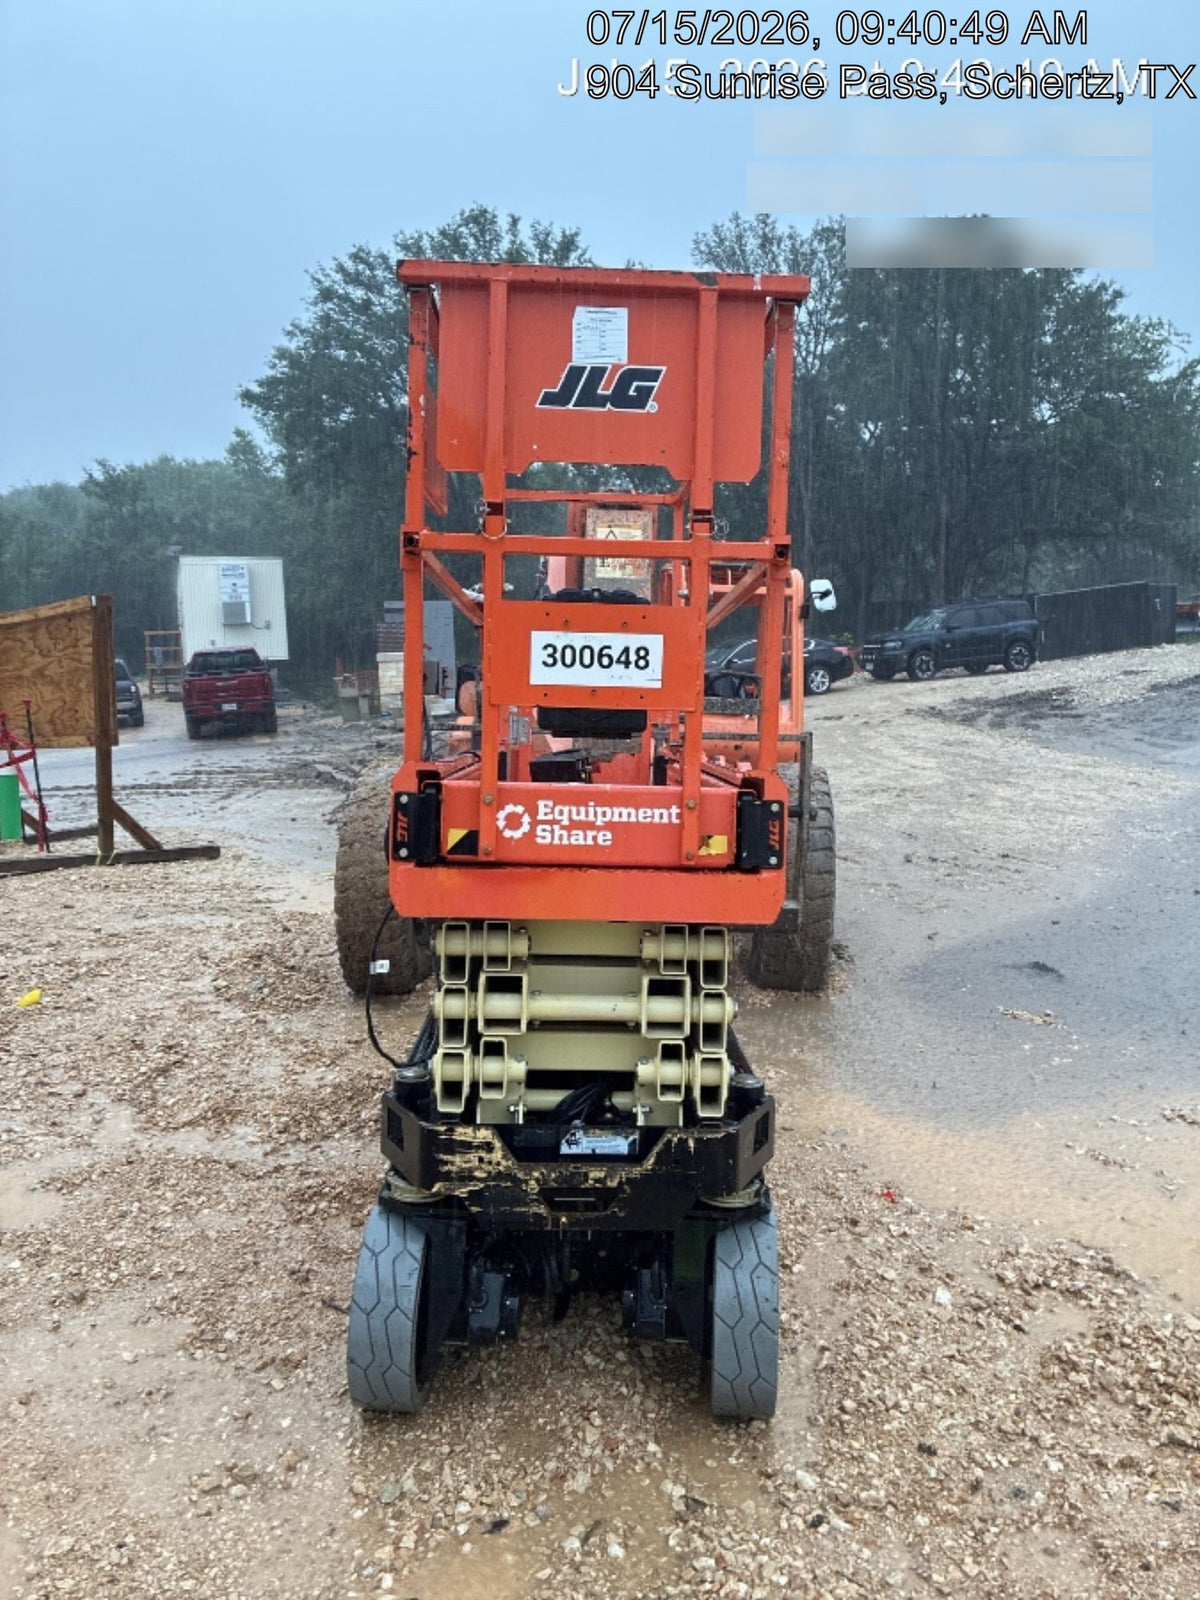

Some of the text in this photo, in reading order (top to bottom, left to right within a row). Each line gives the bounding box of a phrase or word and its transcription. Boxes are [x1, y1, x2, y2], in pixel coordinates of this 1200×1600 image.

[536, 364, 666, 411] JLG
[541, 643, 650, 670] 300648
[536, 799, 681, 826] Equipment
[535, 825, 613, 846] Share
